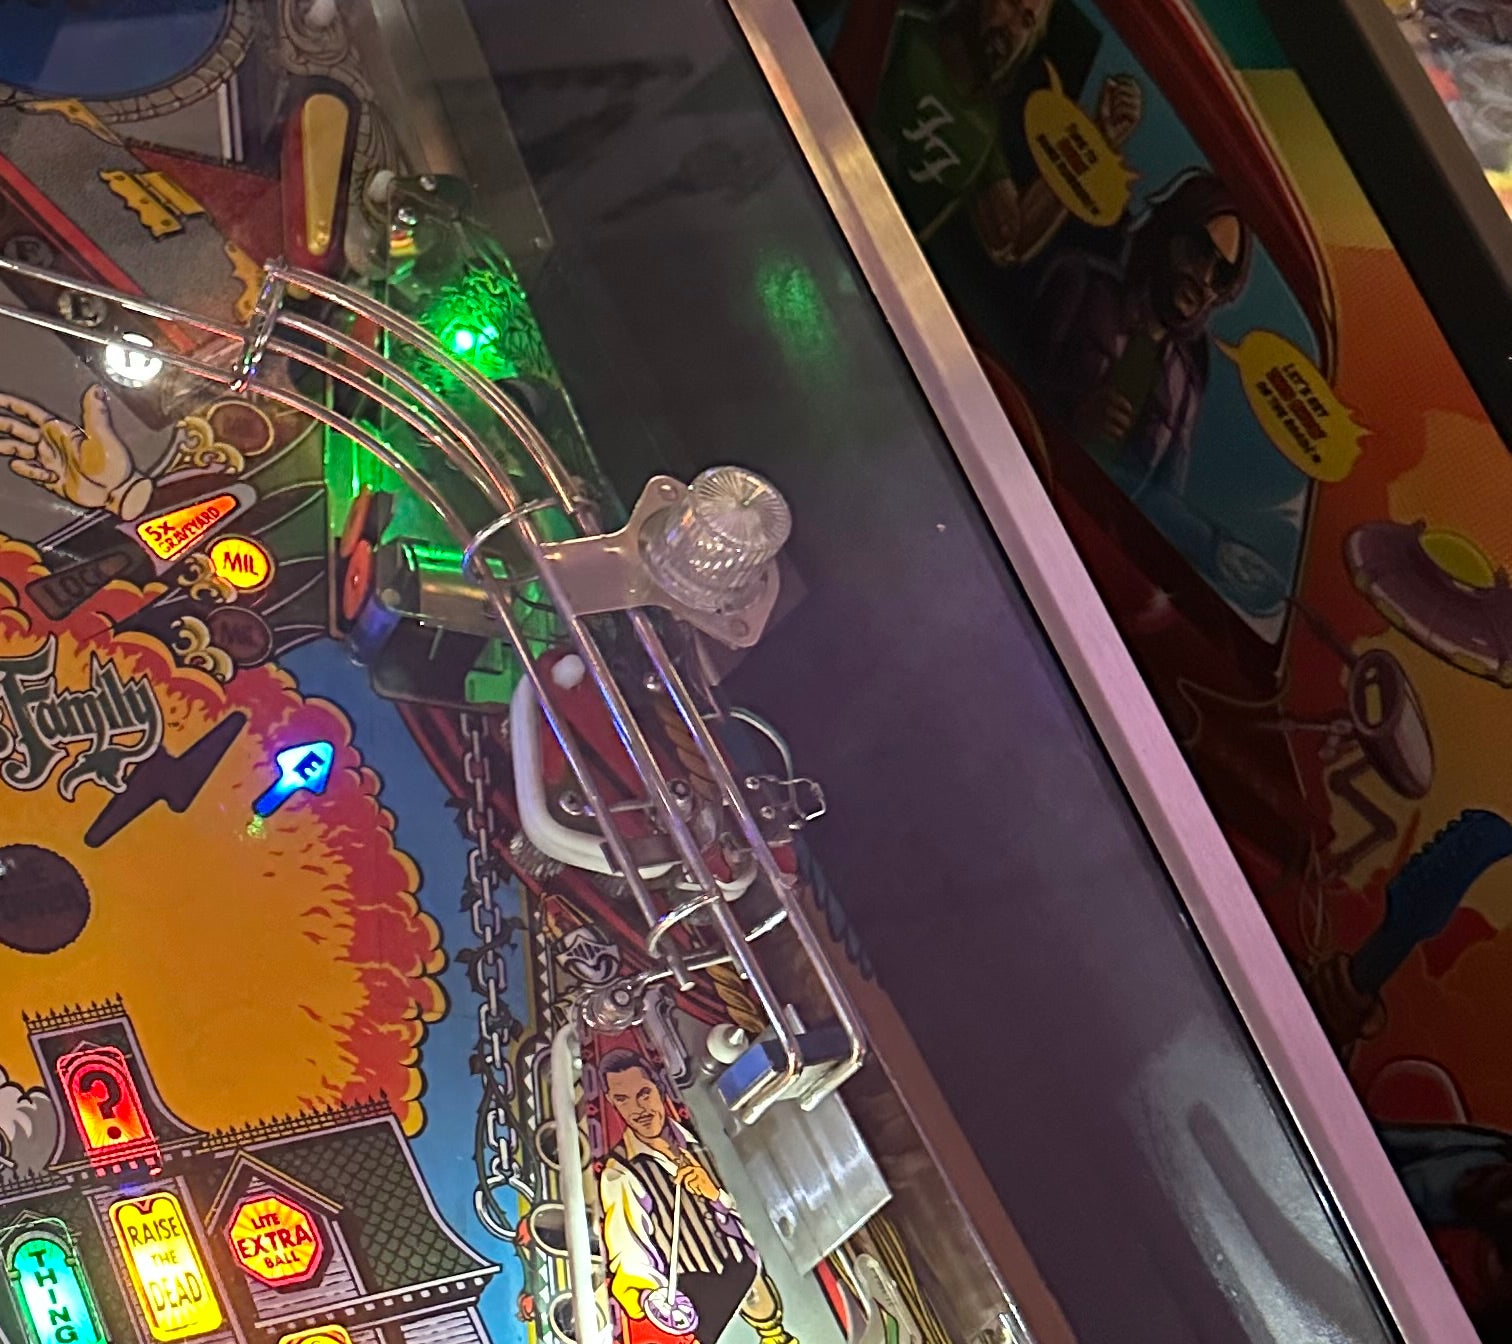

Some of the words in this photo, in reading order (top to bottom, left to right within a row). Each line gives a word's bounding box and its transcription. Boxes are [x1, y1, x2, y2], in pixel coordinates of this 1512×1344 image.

[146, 520, 176, 541] 5X
[159, 507, 220, 553] GRAVEYARD
[223, 552, 258, 576] MIL
[294, 751, 326, 780] E
[128, 1216, 180, 1247] RAISE
[251, 1213, 280, 1229] LITE
[238, 1224, 312, 1258] EXTRA
[151, 1250, 177, 1264] THE
[265, 1251, 300, 1269] BALL
[28, 1249, 78, 1344] THING
[149, 1272, 202, 1311] DEAD
